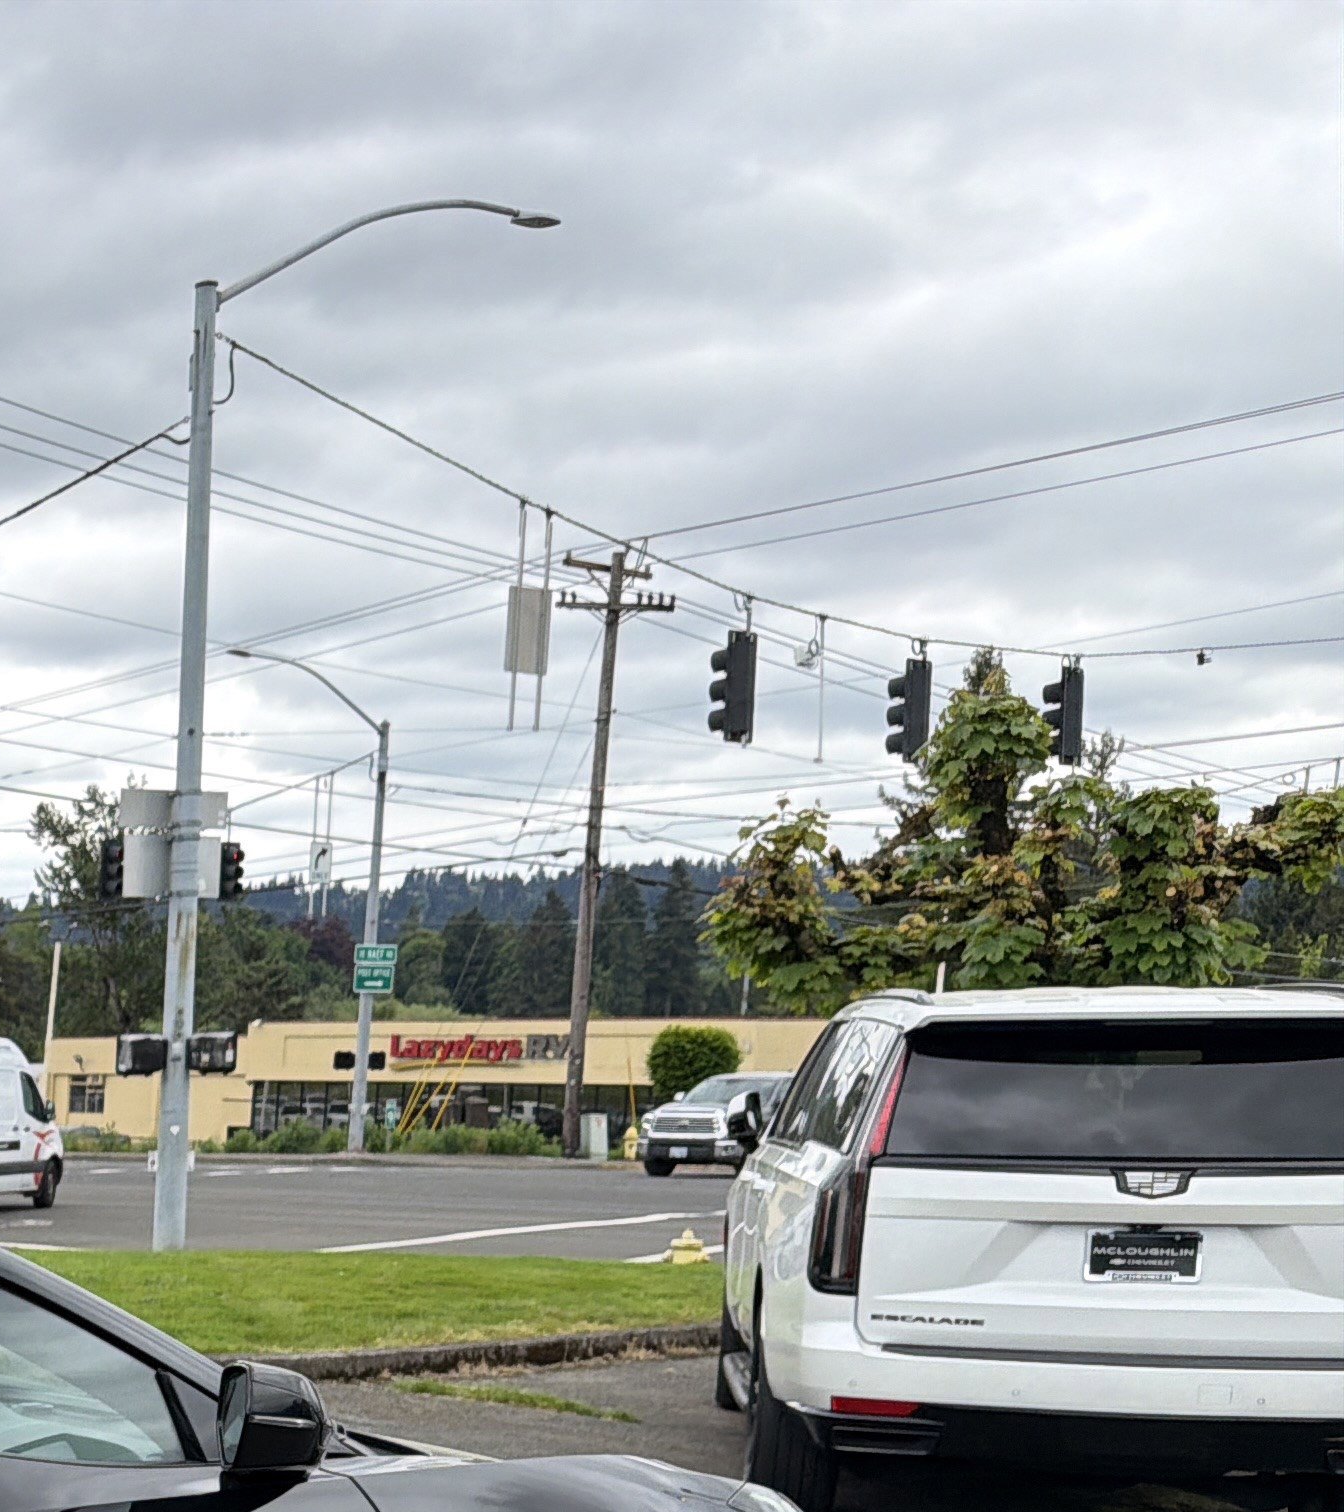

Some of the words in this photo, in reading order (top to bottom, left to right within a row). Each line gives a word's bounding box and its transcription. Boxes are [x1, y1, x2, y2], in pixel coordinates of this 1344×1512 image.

[390, 1034, 524, 1062] Lazydays
[1092, 1246, 1195, 1257] MCLOUGHLIN
[870, 1313, 985, 1326] ESCALADE
